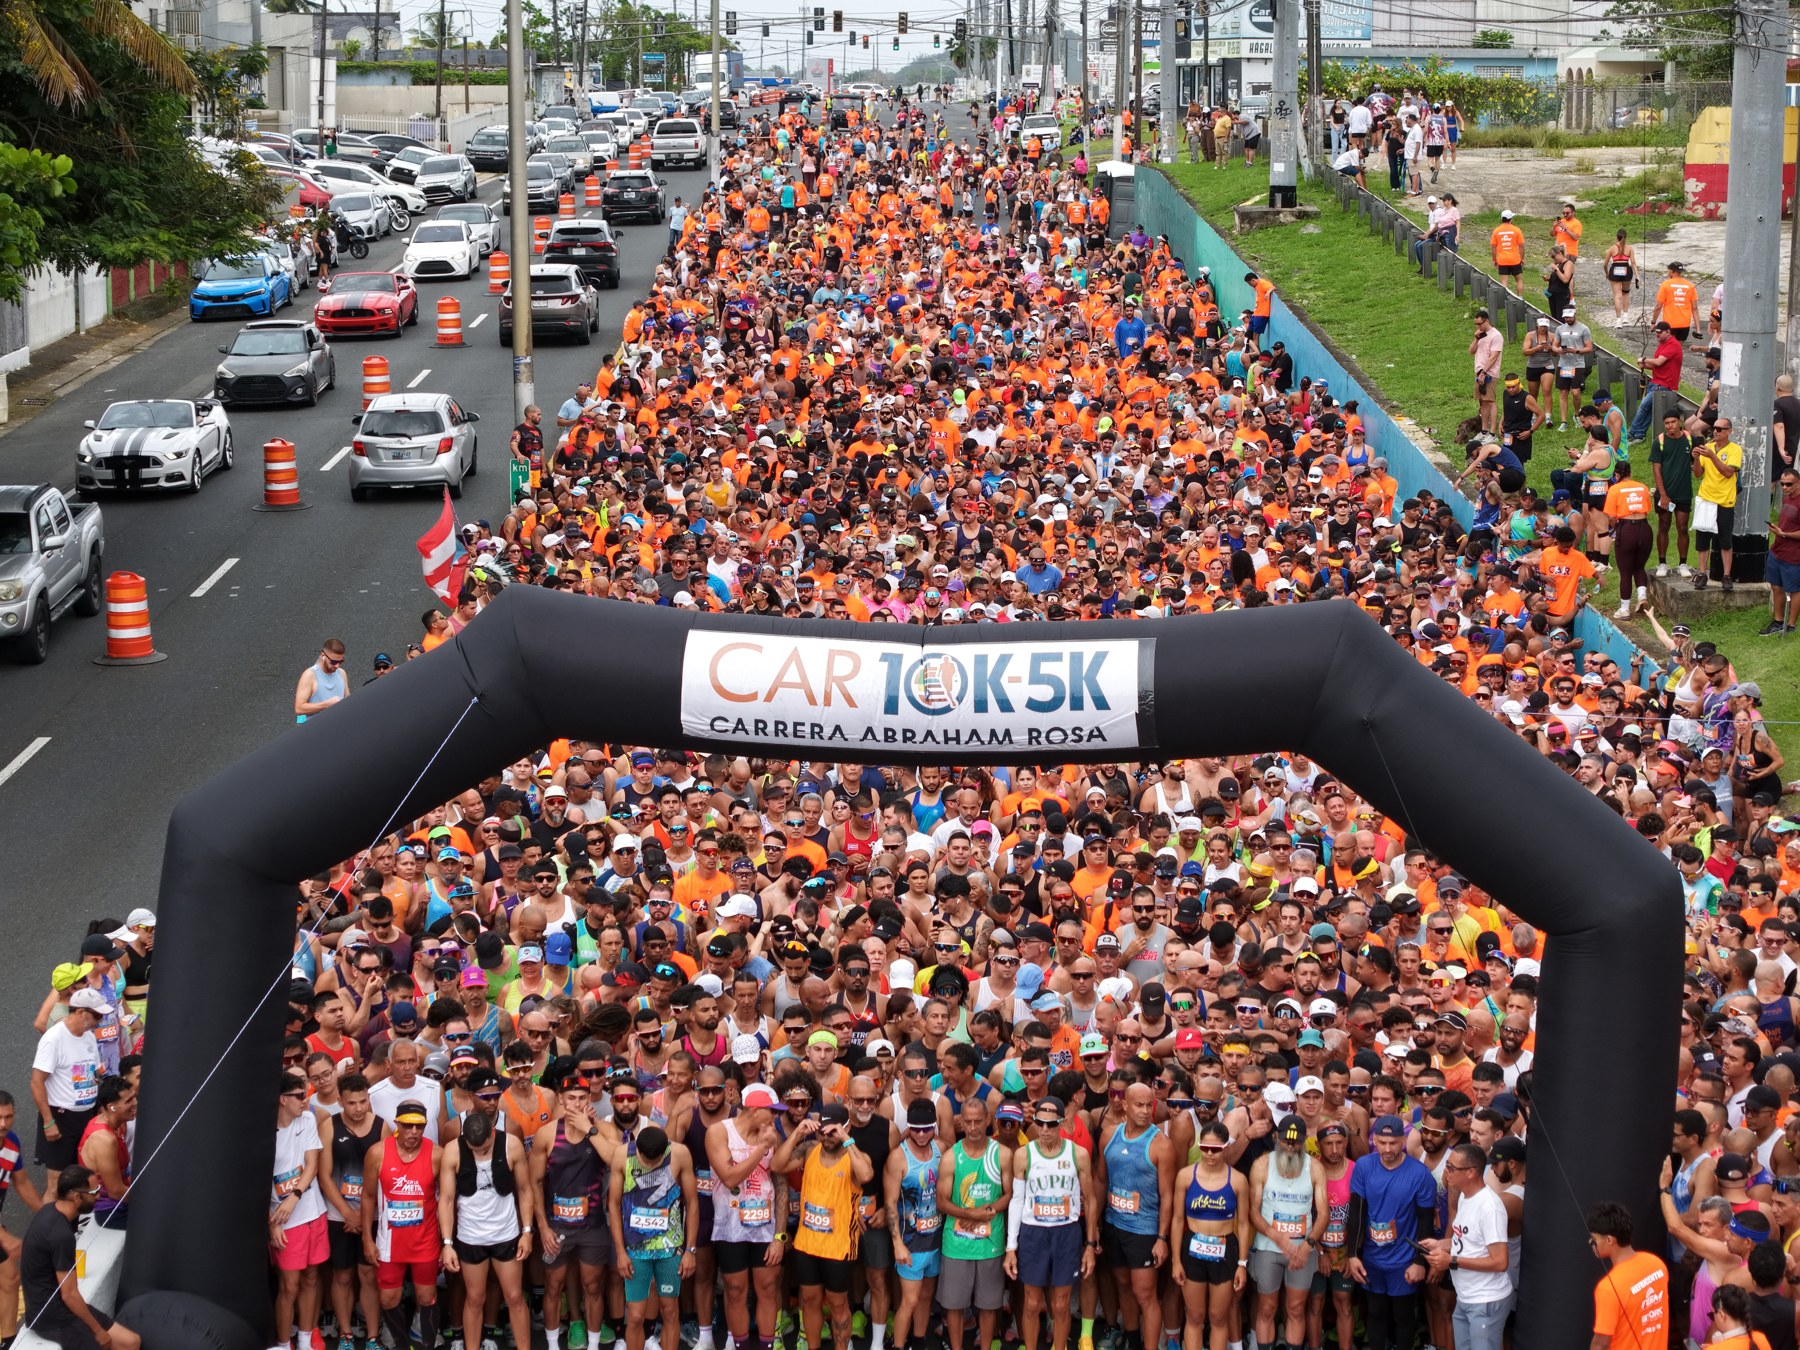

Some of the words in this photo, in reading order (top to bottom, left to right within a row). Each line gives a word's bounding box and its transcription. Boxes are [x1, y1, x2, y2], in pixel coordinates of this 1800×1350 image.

[512, 463, 528, 472] km
[709, 715, 849, 742] CARRERA
[859, 725, 1012, 744] ABRAHAM
[1028, 725, 1108, 744] ROSA
[1111, 1194, 1134, 1210] 1566
[391, 1209, 420, 1220] 2,527
[558, 1205, 584, 1217] 1372
[743, 1208, 770, 1220] 2298
[1038, 1205, 1065, 1216] 1863
[634, 1216, 665, 1228] 2,542
[805, 1212, 830, 1226] 2309
[1276, 1221, 1302, 1233] 1385
[1195, 1243, 1222, 1255] 2,521
